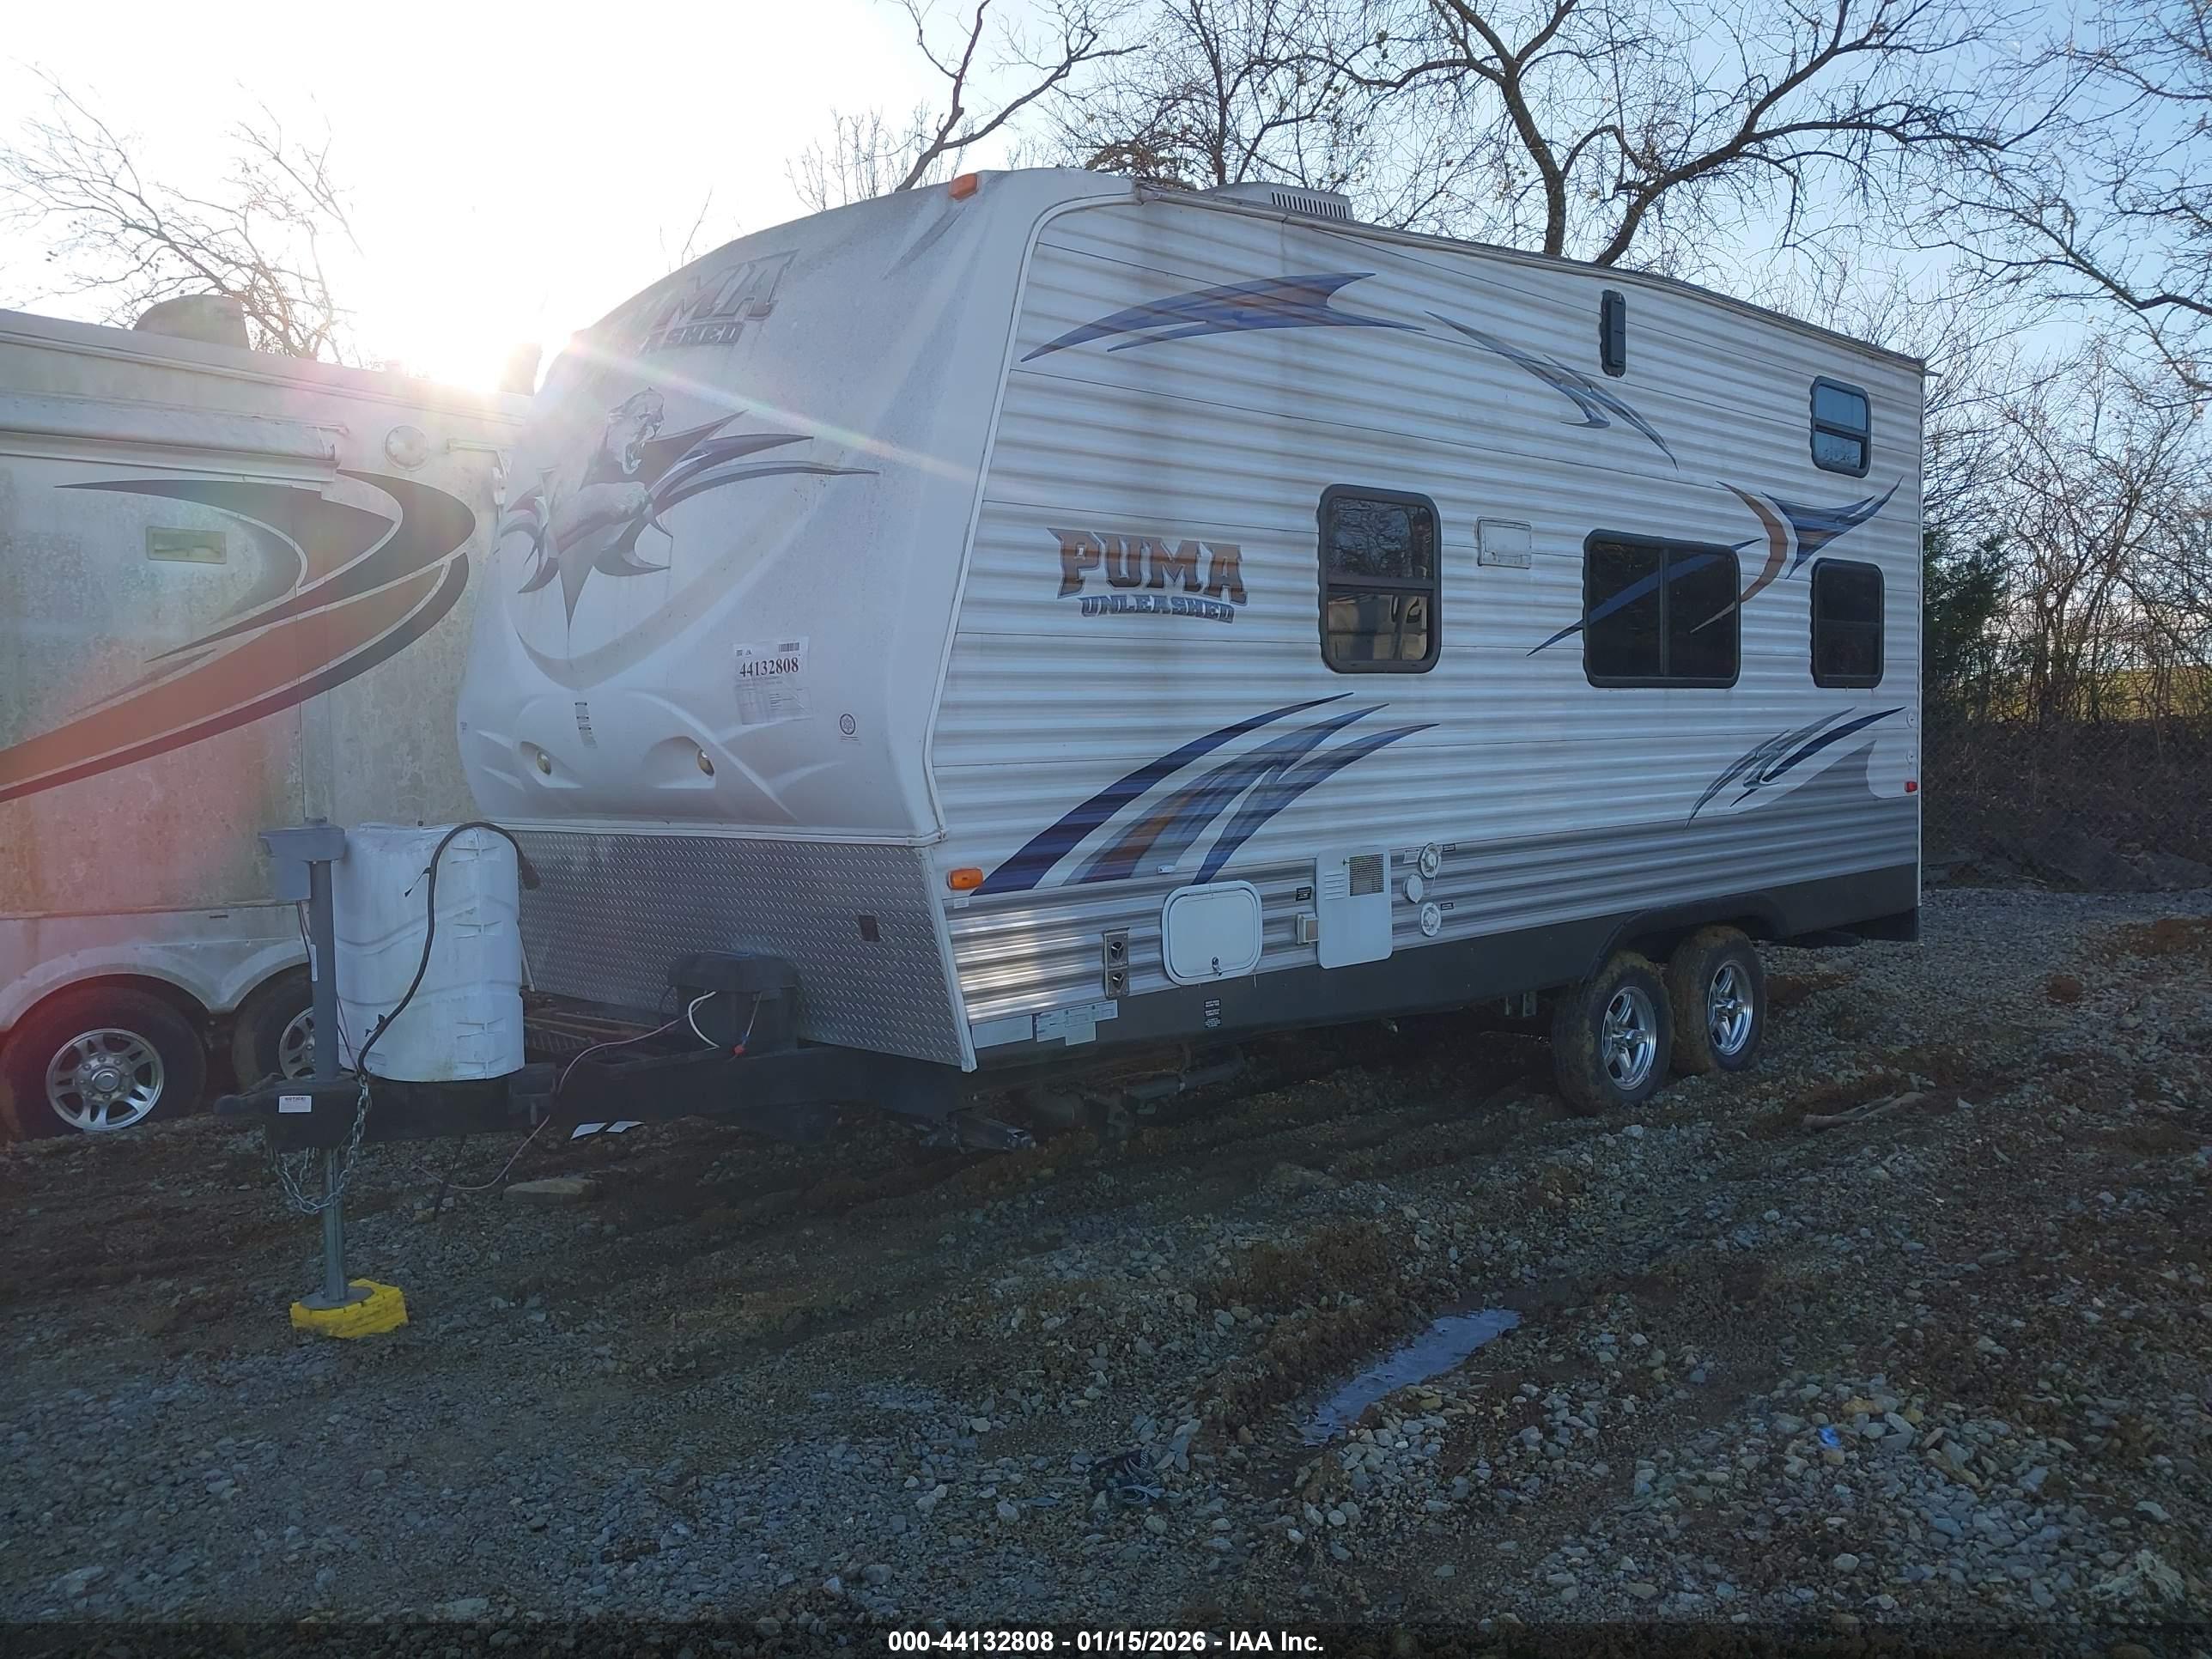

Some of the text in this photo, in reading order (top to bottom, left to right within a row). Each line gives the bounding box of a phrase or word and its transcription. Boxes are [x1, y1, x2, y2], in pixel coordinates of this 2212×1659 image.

[1047, 527, 1248, 605] PUMA
[1079, 594, 1235, 624] UNLEASHED
[739, 657, 799, 678] 44132808
